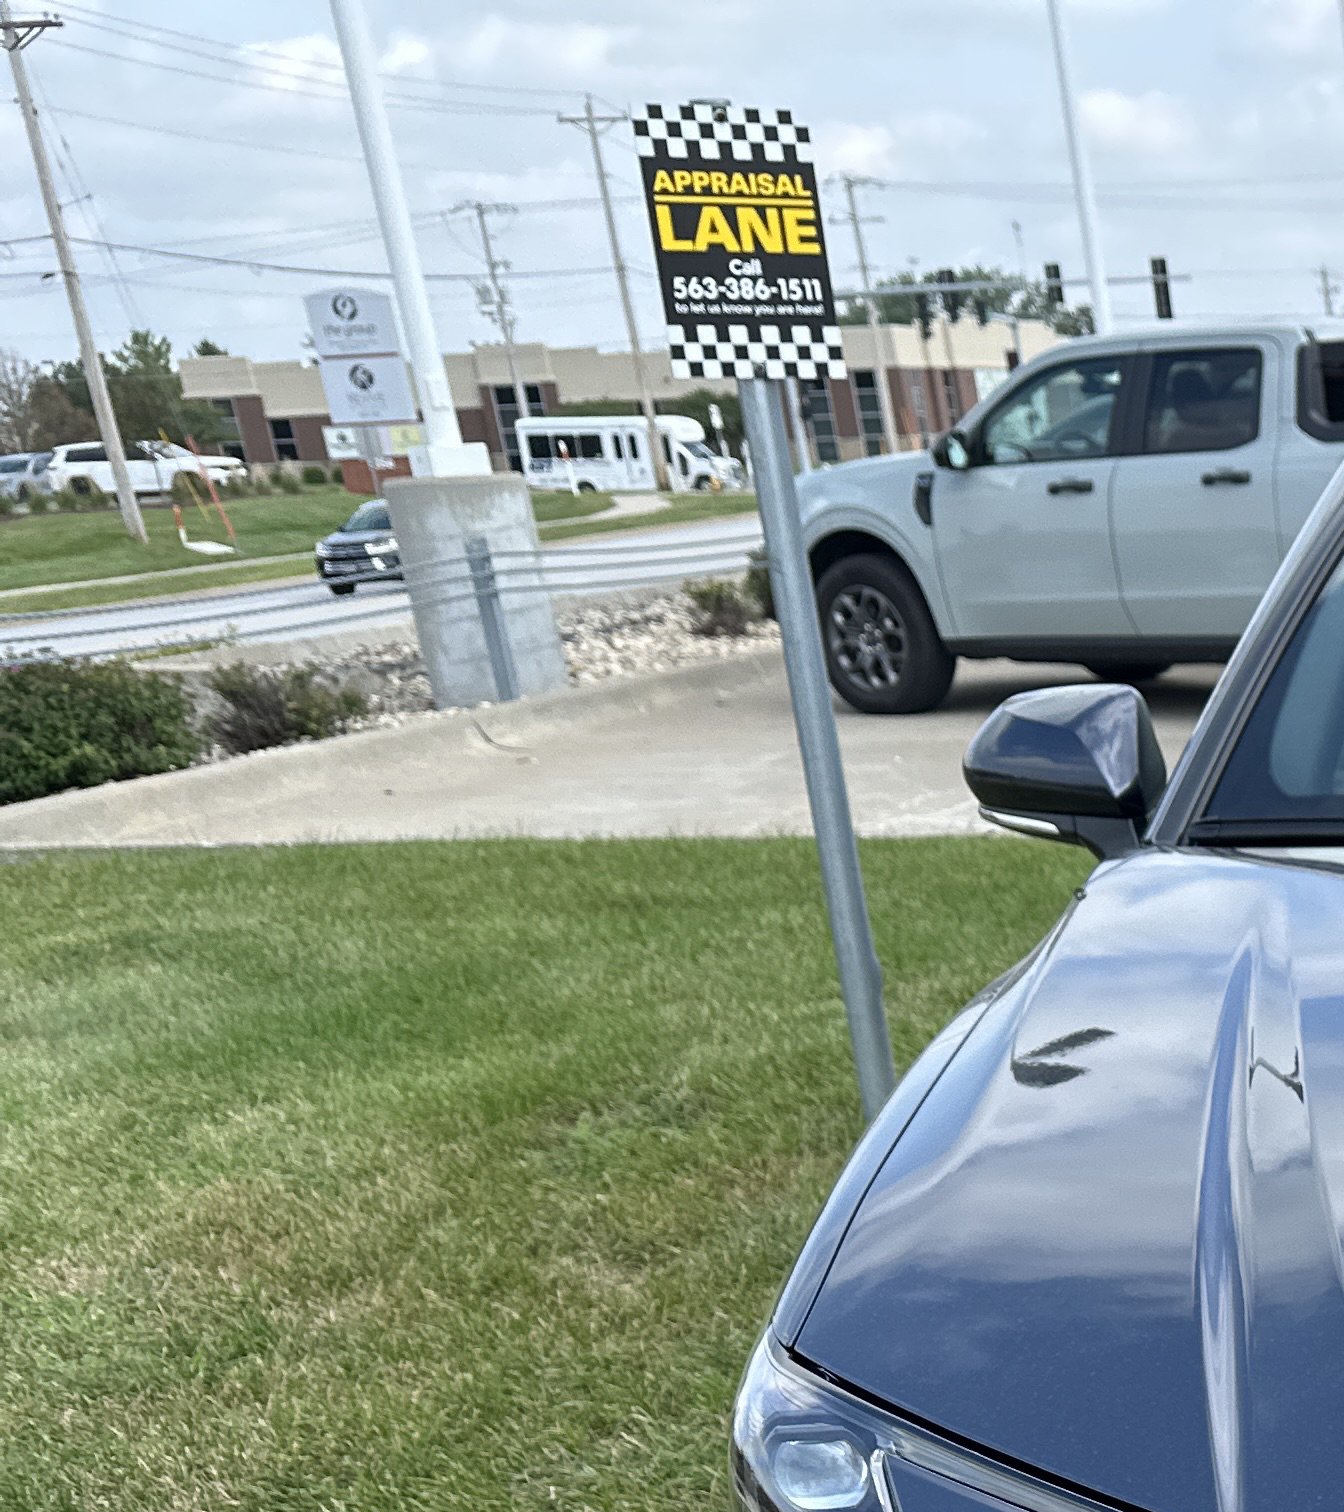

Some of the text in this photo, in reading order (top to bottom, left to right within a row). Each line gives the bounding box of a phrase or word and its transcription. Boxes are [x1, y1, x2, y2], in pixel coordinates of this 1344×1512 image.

[653, 169, 811, 197] APPRAISAL
[655, 204, 822, 255] LANE
[728, 258, 763, 276] Call
[673, 276, 823, 301] 563-386-1511
[722, 303, 753, 315] know
[754, 305, 776, 317] you
